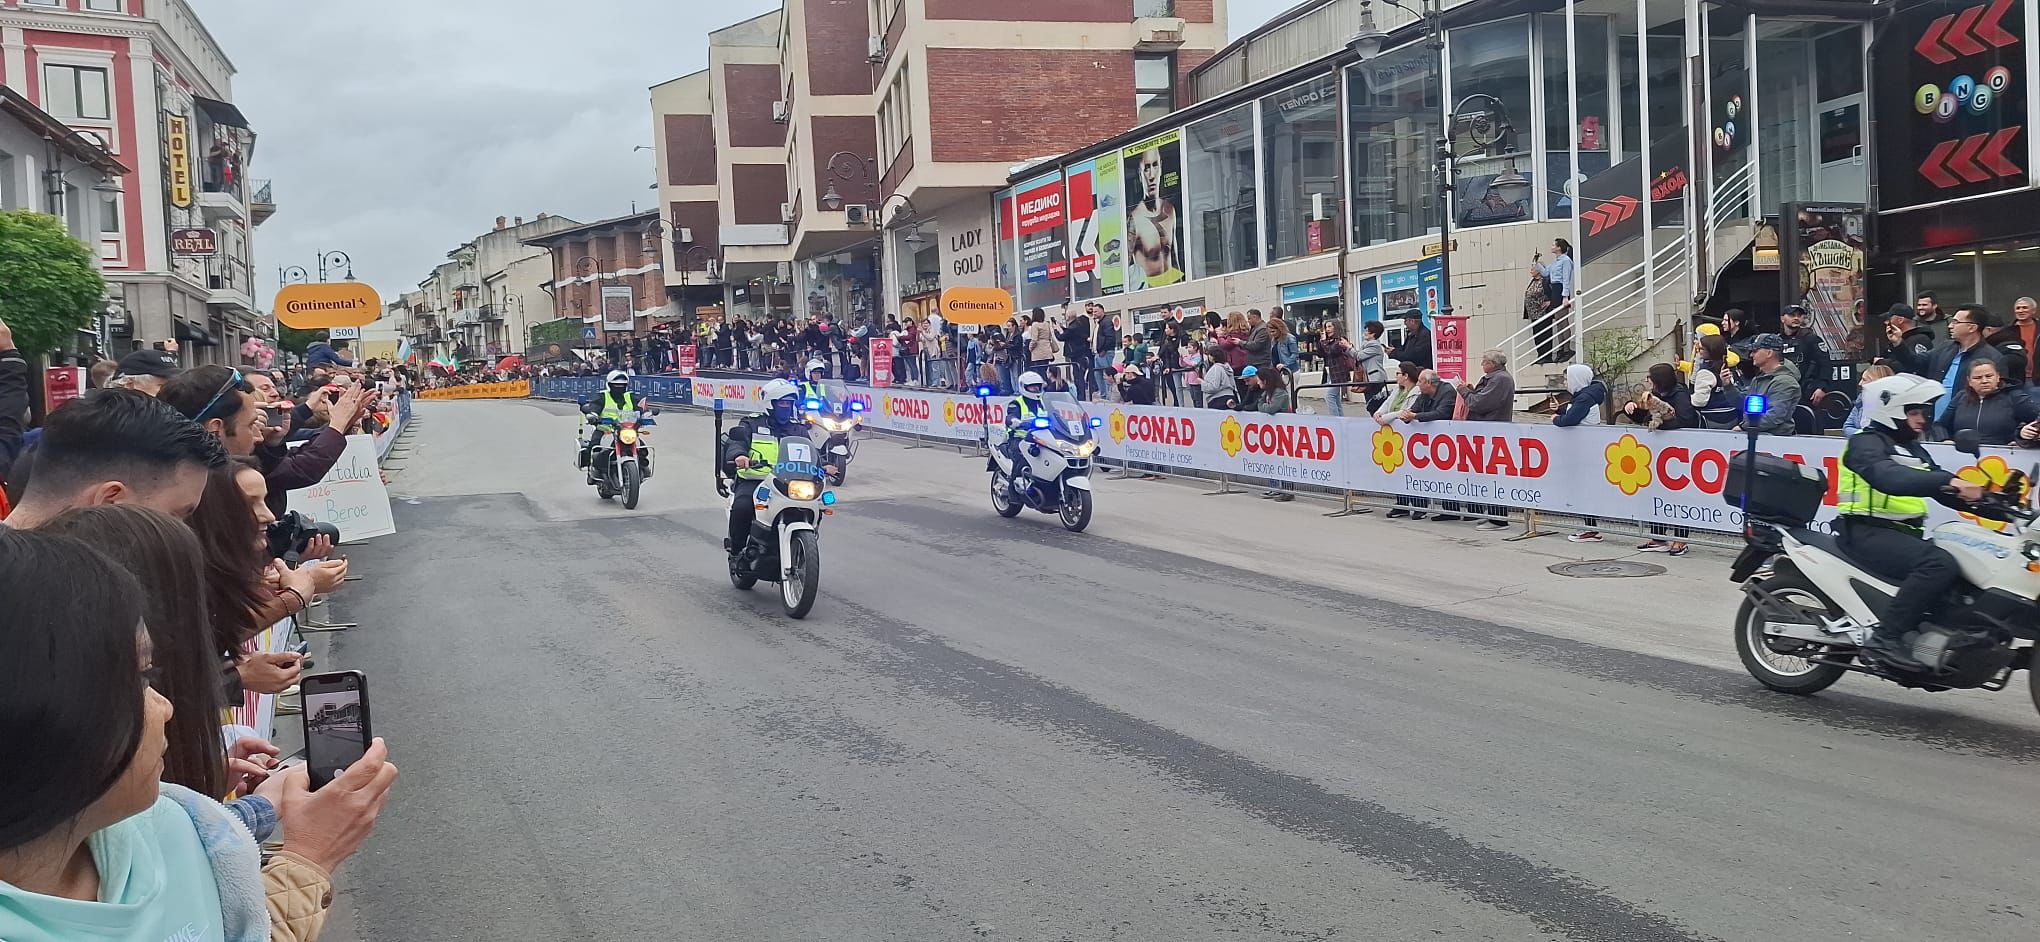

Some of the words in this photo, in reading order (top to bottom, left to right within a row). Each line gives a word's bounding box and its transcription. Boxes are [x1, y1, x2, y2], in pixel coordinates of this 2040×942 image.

[1925, 75, 2004, 113] BINGO
[171, 120, 187, 201] HOTEL
[1651, 170, 1687, 200] ВХОД
[1020, 193, 1060, 216] МЕДИКО
[174, 239, 214, 252] REAL
[951, 228, 982, 252] LADY
[953, 254, 983, 276] GOLD
[286, 299, 356, 314] Continental
[949, 299, 997, 311] Continental
[335, 328, 354, 337] 500
[724, 384, 746, 400] CONAD
[892, 397, 930, 420] CONAD
[956, 403, 1004, 424] CONAD
[1073, 424, 1080, 433] 9
[1127, 414, 1196, 447] CONAD
[1243, 423, 1335, 461] CONAD
[796, 448, 803, 460] 7
[1406, 432, 1549, 478] CONAD
[775, 462, 825, 479] POLICE
[1243, 457, 1275, 476] Persone
[1277, 460, 1298, 477] oltre
[1300, 464, 1308, 479] le
[1311, 468, 1332, 481] cose
[307, 486, 331, 498] 2026
[1405, 474, 1453, 493] Persone
[1457, 478, 1489, 498] oltre
[1493, 480, 1505, 499] le
[1510, 487, 1542, 503] cose
[326, 499, 368, 521] Beroe
[1653, 497, 1722, 523] Persone
